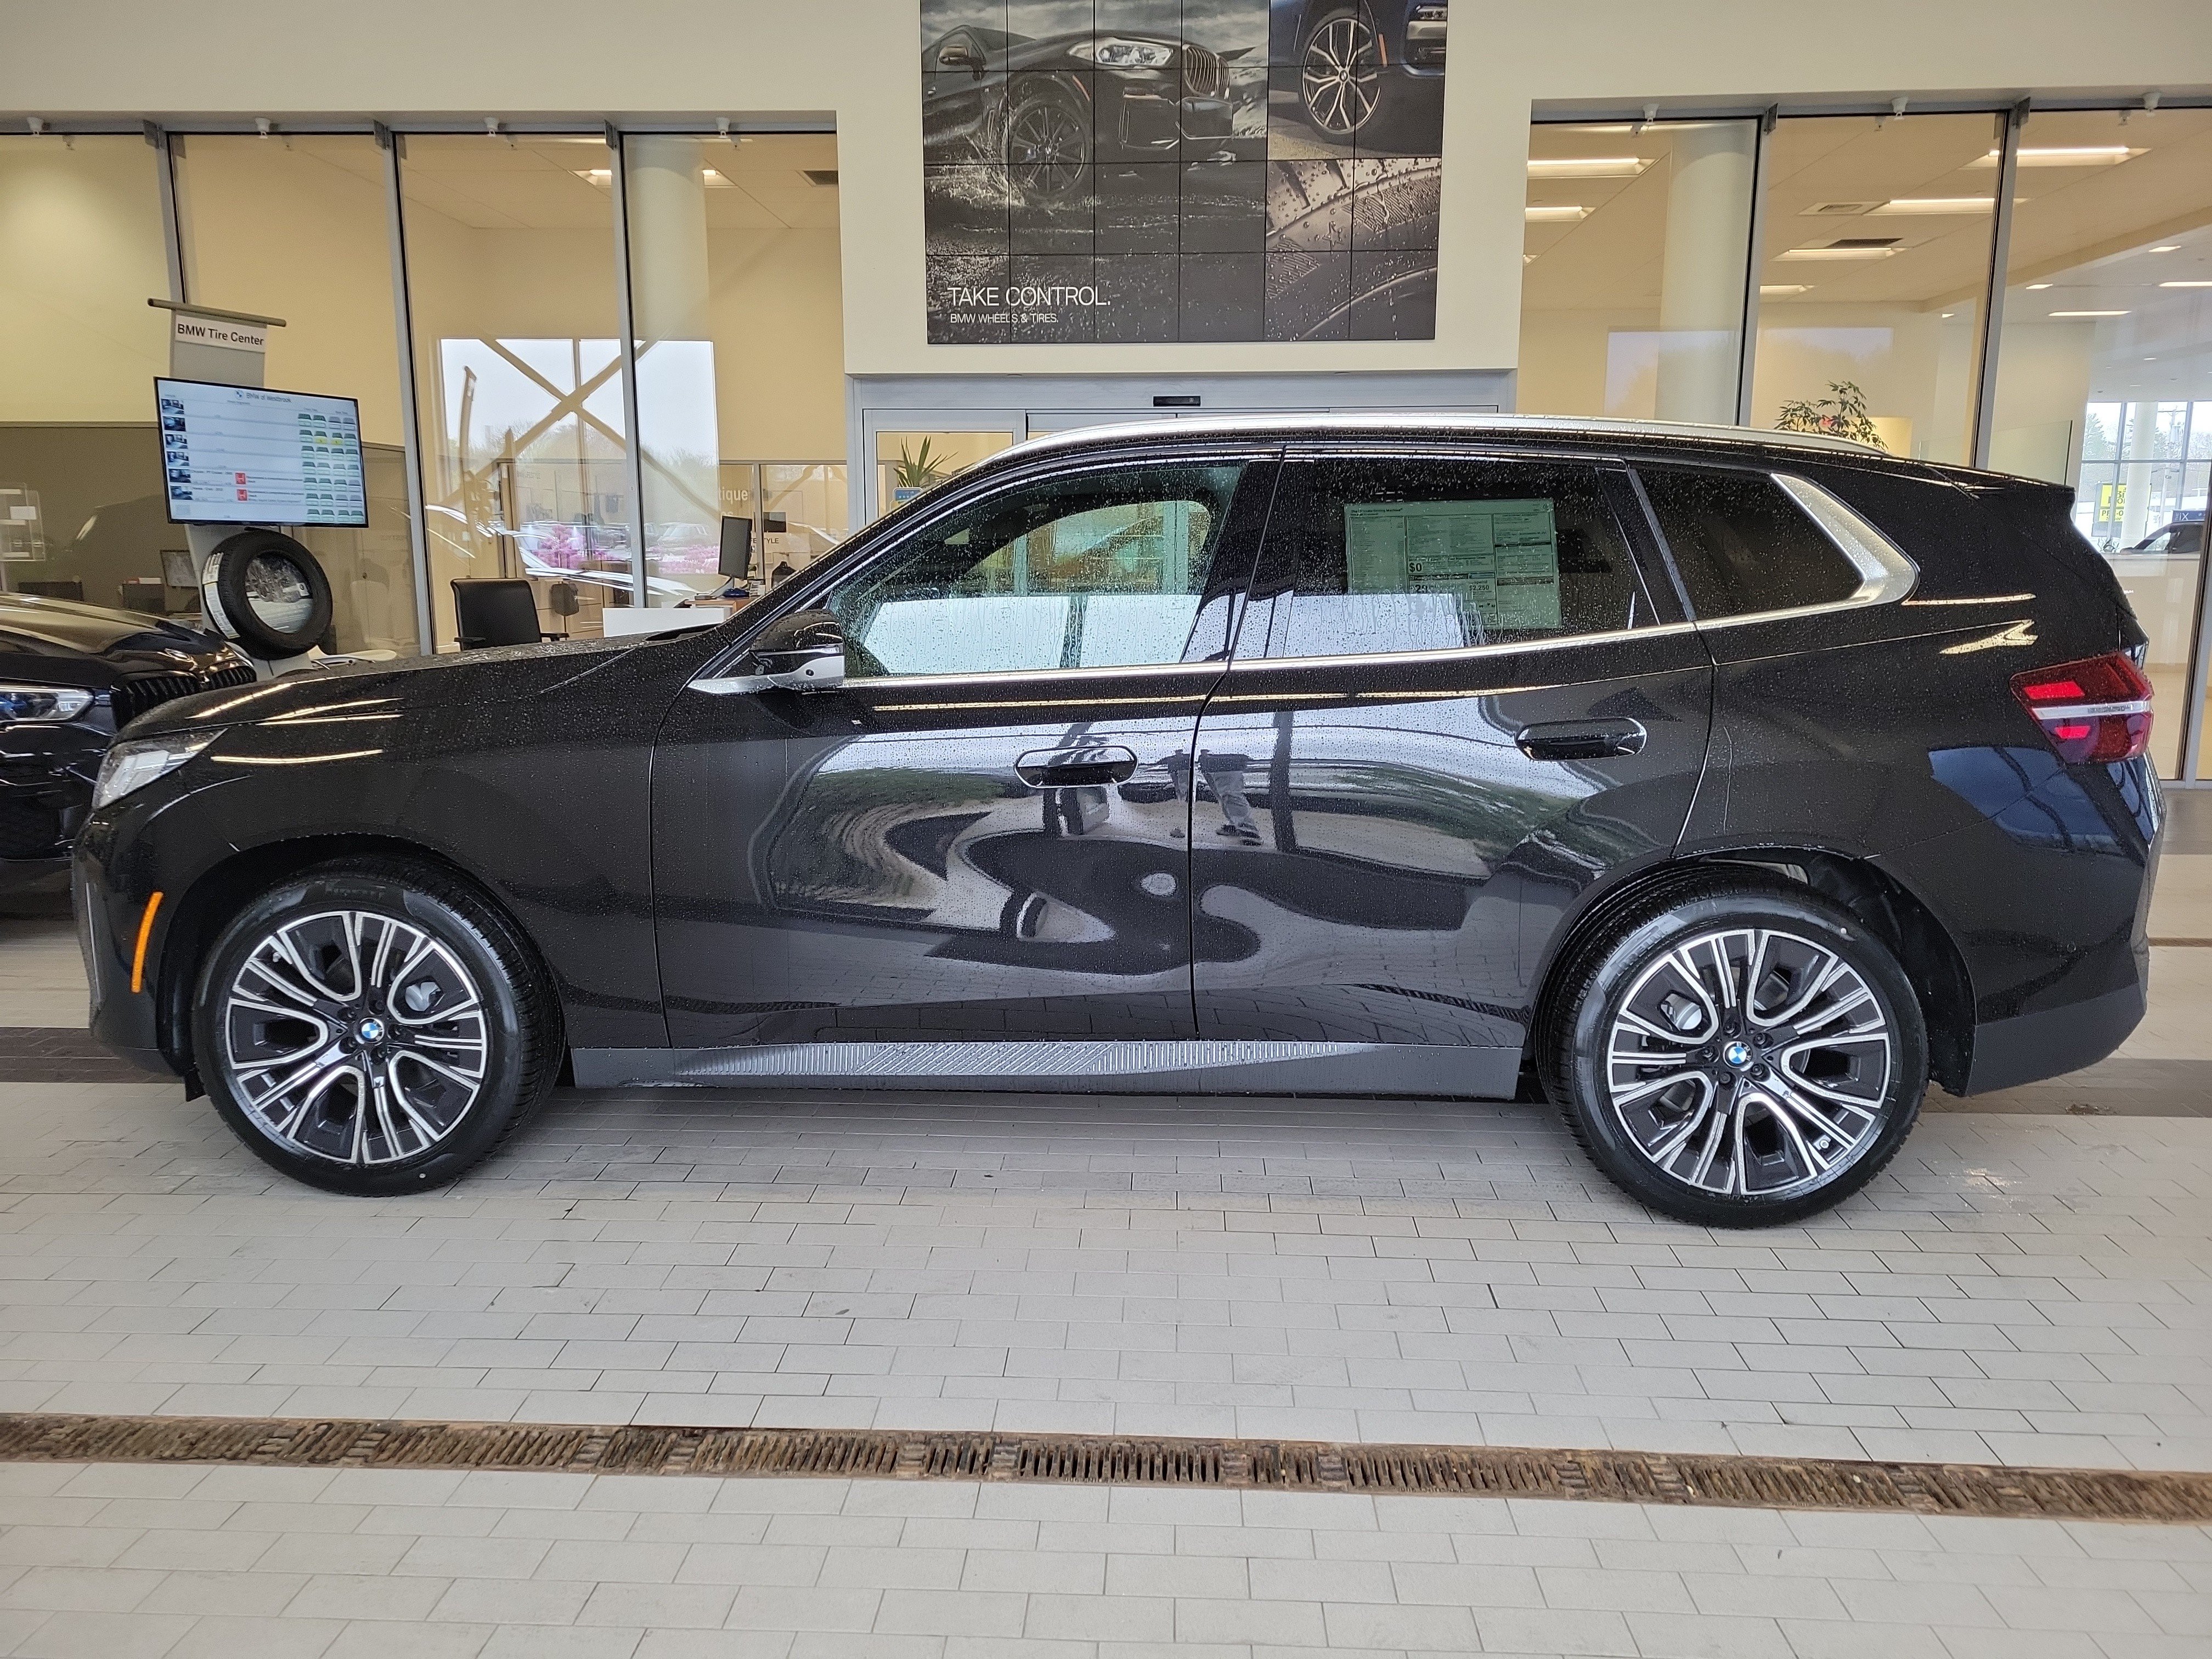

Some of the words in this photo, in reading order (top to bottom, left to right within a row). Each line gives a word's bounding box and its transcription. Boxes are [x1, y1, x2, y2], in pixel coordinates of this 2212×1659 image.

[947, 287, 1000, 306] TAKE
[1006, 286, 1111, 306] CONTROL.
[950, 313, 975, 323] BMW
[978, 313, 1018, 323] WHEELS
[1021, 313, 1028, 323] &
[1032, 313, 1059, 323] TIRES.
[177, 323, 205, 337] BMW
[208, 328, 228, 341] Tire
[230, 332, 264, 345] Center
[2179, 512, 2189, 521] iX
[1409, 562, 1422, 573] $0
